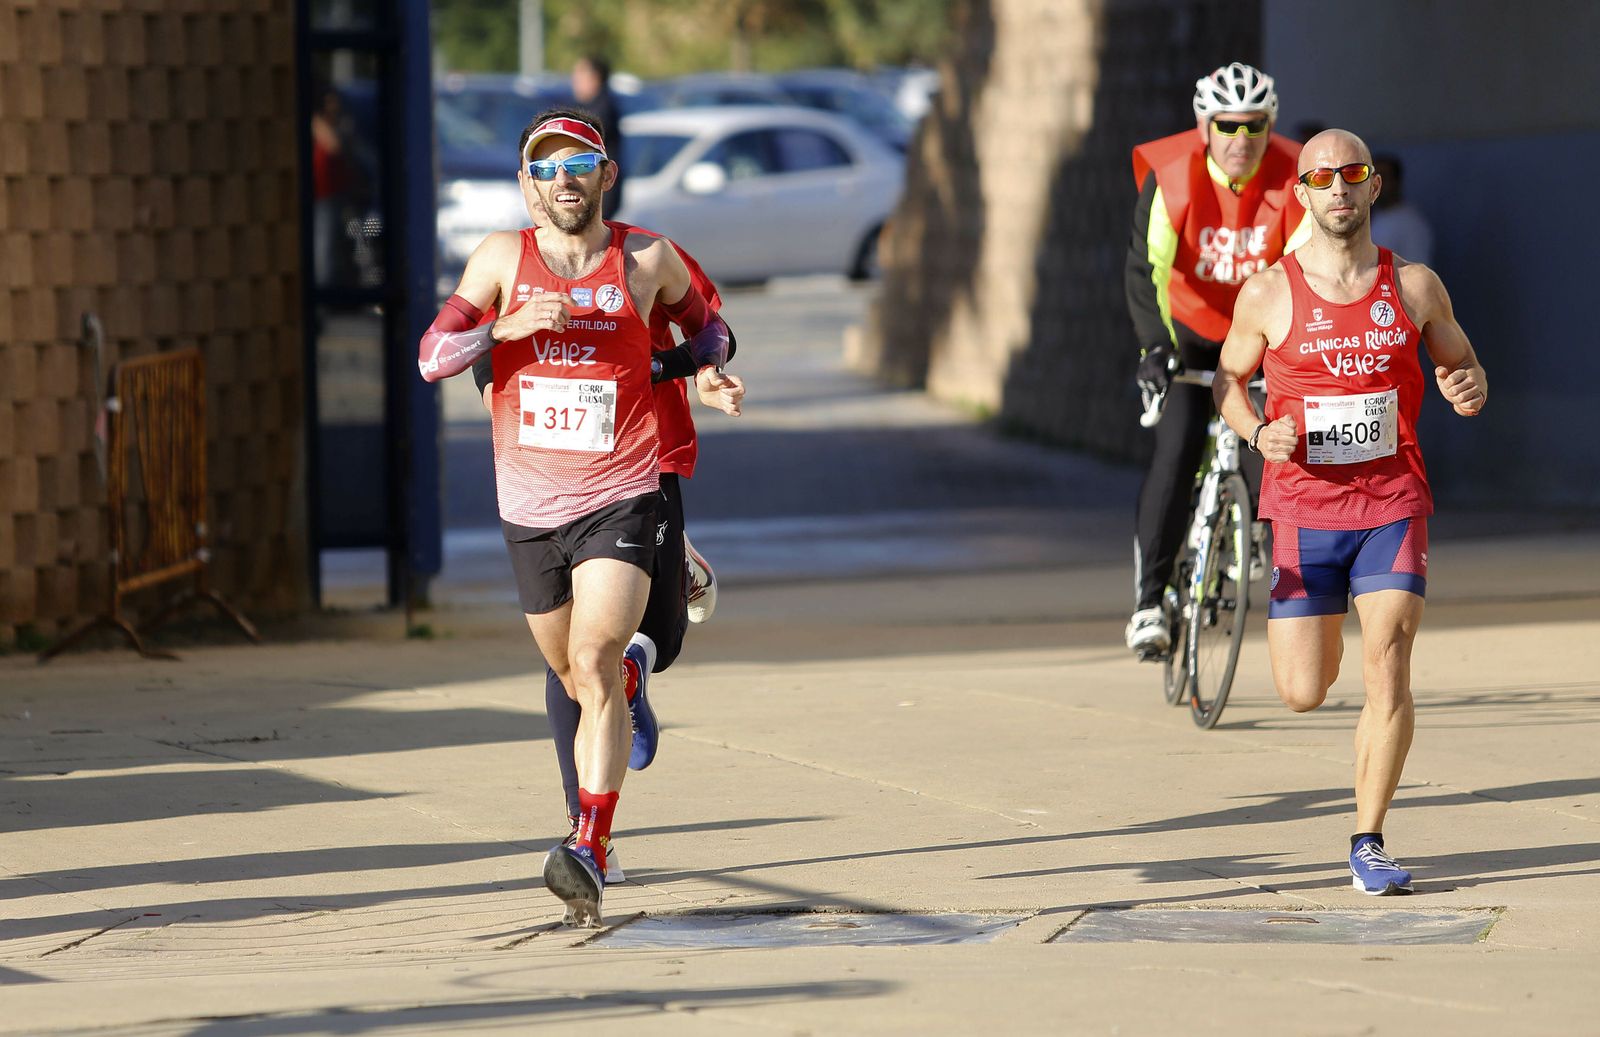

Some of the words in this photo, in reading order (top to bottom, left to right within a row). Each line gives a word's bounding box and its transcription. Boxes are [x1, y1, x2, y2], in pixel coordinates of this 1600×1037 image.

[438, 351, 461, 364] Brave
[460, 340, 481, 354] Heart
[532, 336, 597, 367] Vélez
[1299, 336, 1360, 354] CLÍNICAS
[1321, 352, 1391, 377] Vélez
[544, 407, 587, 431] 317
[1326, 420, 1380, 446] 4508
